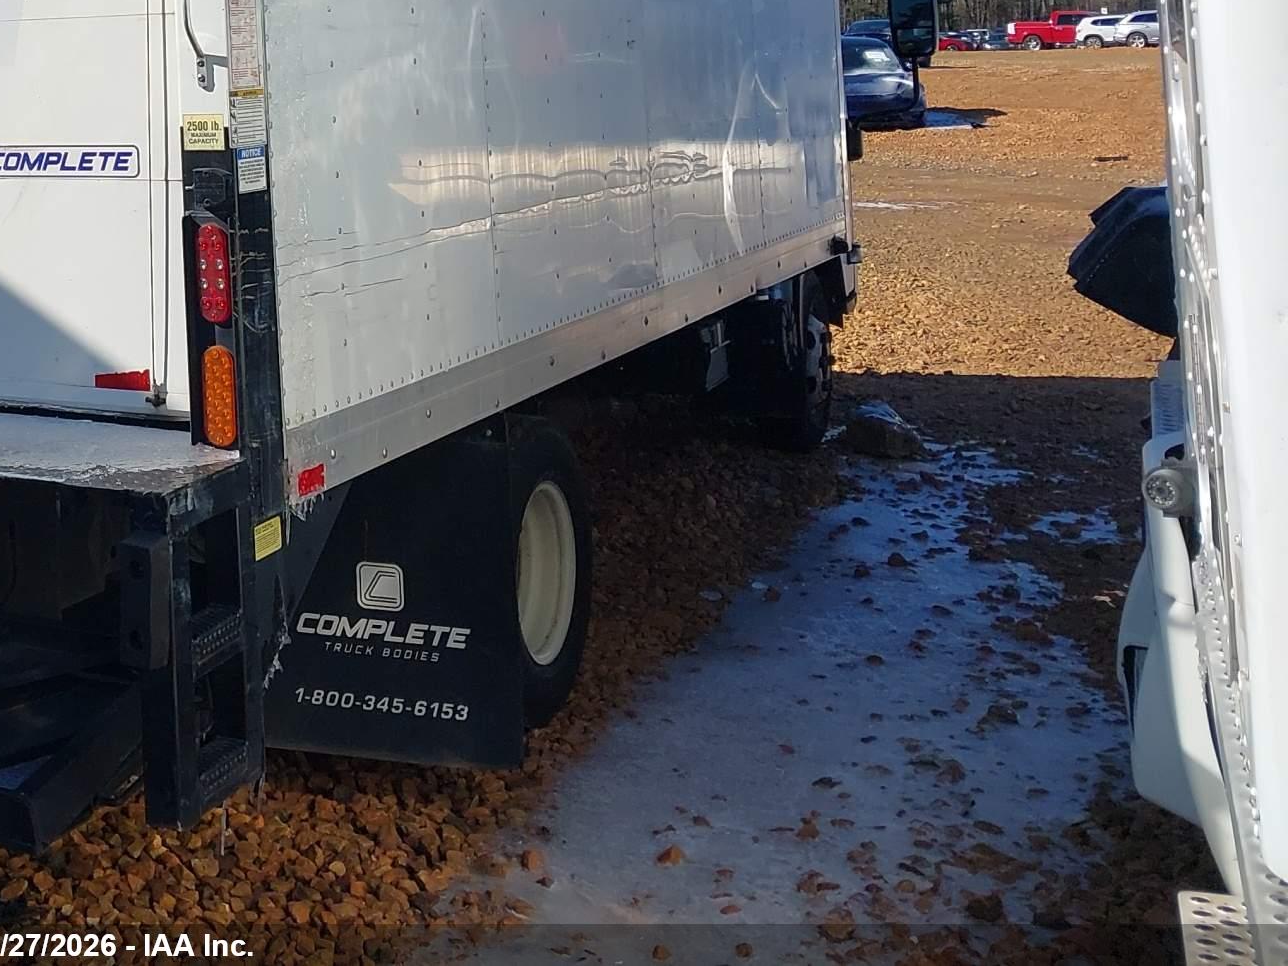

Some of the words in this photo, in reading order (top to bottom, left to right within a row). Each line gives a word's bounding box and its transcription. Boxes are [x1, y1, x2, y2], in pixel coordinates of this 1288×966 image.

[187, 120, 208, 131] 2500
[211, 120, 222, 131] lb.
[241, 148, 261, 156] NOTICE
[296, 612, 471, 649] COMPLETE
[324, 642, 374, 655] TRUCK
[382, 648, 440, 662] BODIES
[295, 688, 469, 721] 1-800-345-6153
